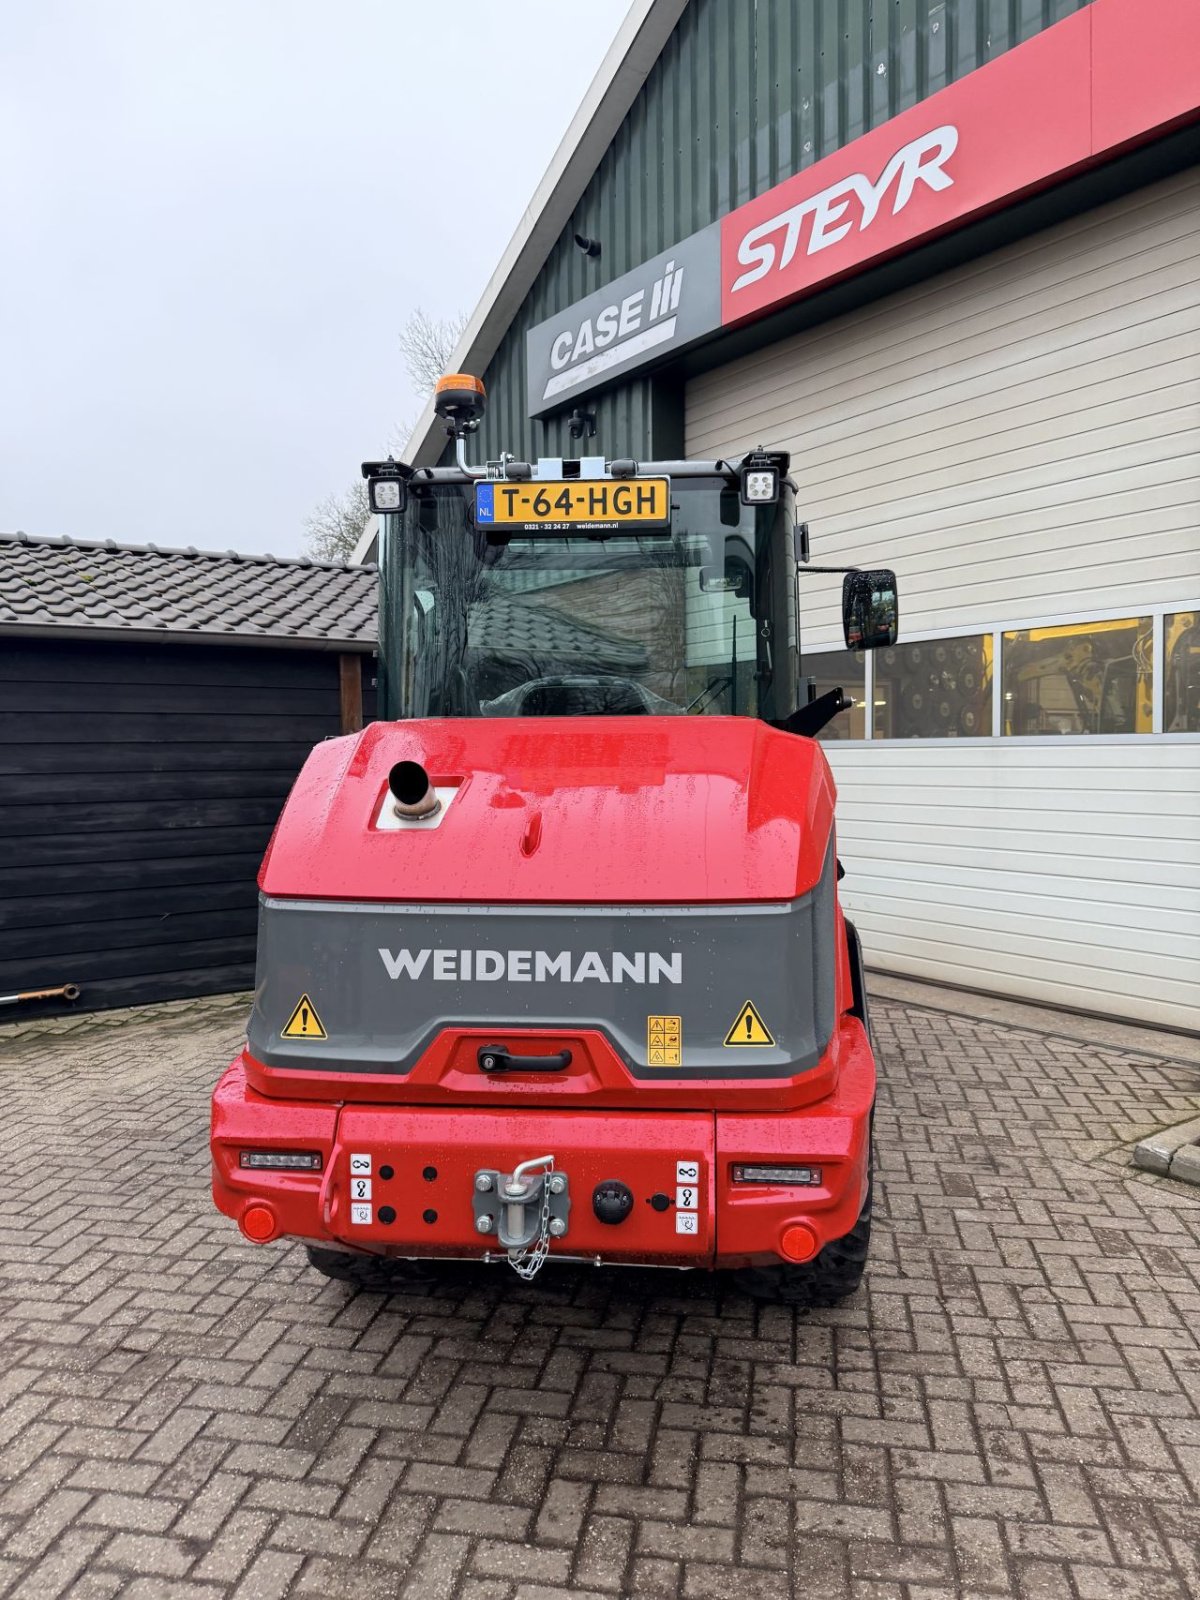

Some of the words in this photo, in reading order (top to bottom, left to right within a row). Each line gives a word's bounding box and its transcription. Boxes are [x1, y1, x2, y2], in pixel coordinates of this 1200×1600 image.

[731, 125, 959, 293] STEYR
[551, 289, 645, 370] CASE
[479, 508, 492, 517] NL
[502, 486, 656, 517] T-64-HGH
[378, 948, 682, 984] WEIDEMANN
